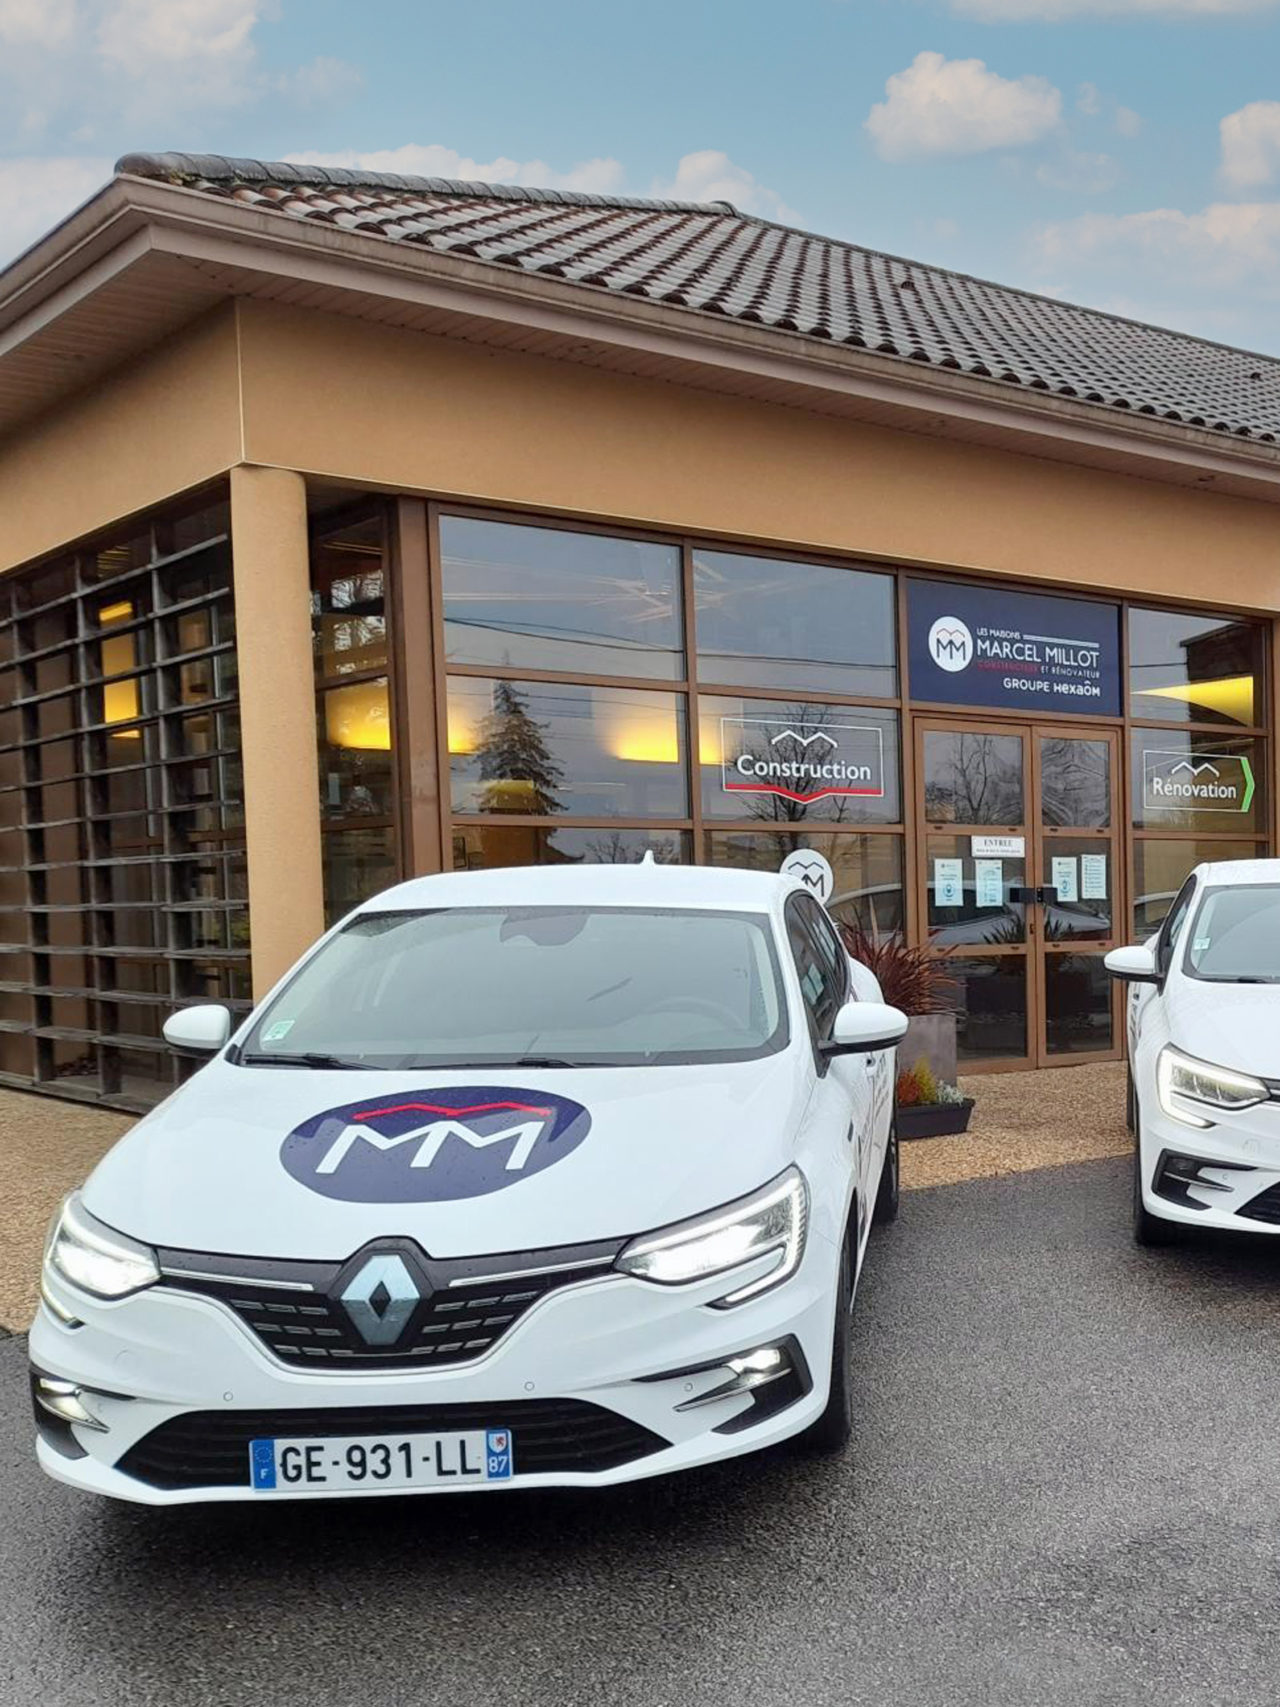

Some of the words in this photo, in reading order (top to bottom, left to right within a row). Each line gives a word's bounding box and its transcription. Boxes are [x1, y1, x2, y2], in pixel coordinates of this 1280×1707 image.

[976, 627, 989, 637] LES
[989, 629, 1022, 640] MAISONS
[976, 638, 1042, 662] MARCEL
[1045, 645, 1100, 668] MILLOT
[1041, 665, 1049, 674] ET
[1003, 677, 1051, 692] GROUPE
[736, 754, 872, 780] Construction
[1152, 778, 1237, 799] Rénovation
[260, 1468, 268, 1480] F
[279, 1438, 482, 1483] GE-931-LL
[488, 1455, 508, 1473] 87
